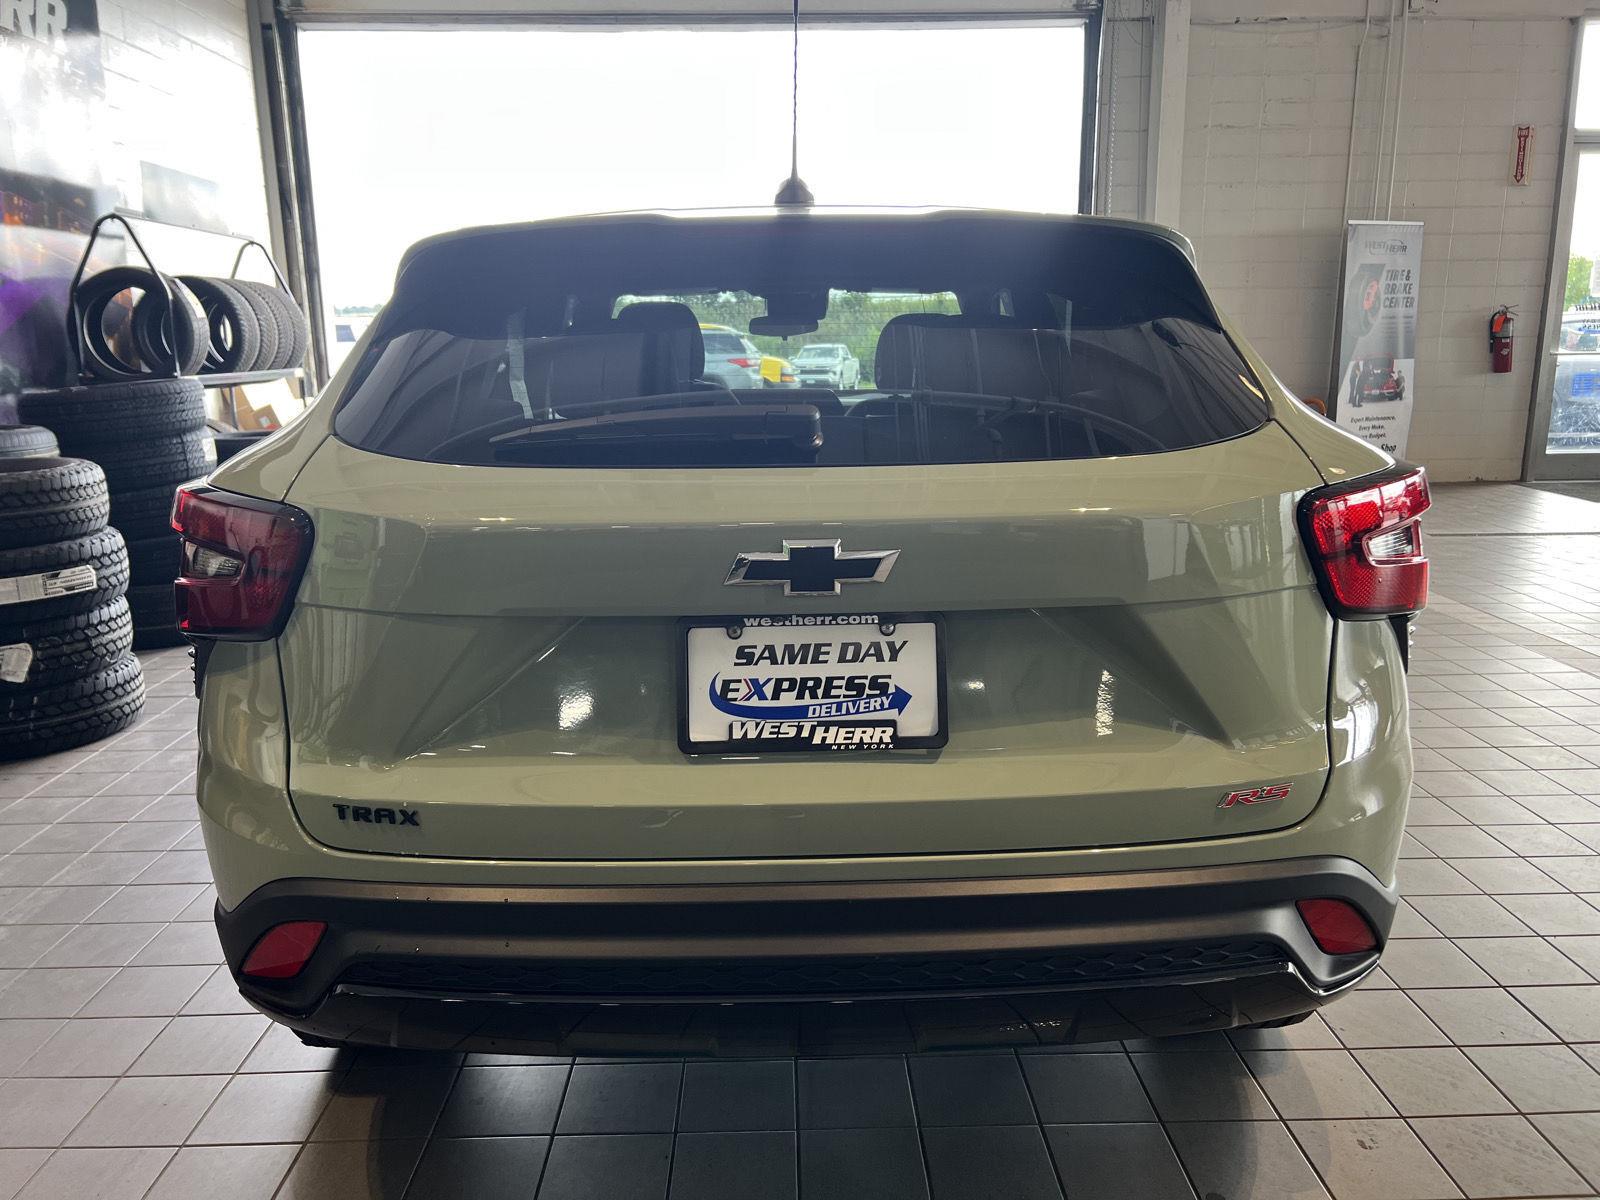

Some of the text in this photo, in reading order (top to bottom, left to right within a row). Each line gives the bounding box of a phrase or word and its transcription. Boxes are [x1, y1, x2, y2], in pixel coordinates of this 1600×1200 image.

[1385, 269, 1405, 281] TIRE
[1384, 283, 1413, 294] BRAKE
[1383, 297, 1415, 308] CENTER
[1381, 443, 1397, 453] Shop
[734, 640, 909, 667] SAME DAY
[719, 674, 892, 702] EXPRESS
[807, 694, 894, 719] DELIVERY
[732, 720, 895, 745] WEST HERR
[1216, 782, 1294, 808] RS
[332, 803, 420, 827] TRAX
